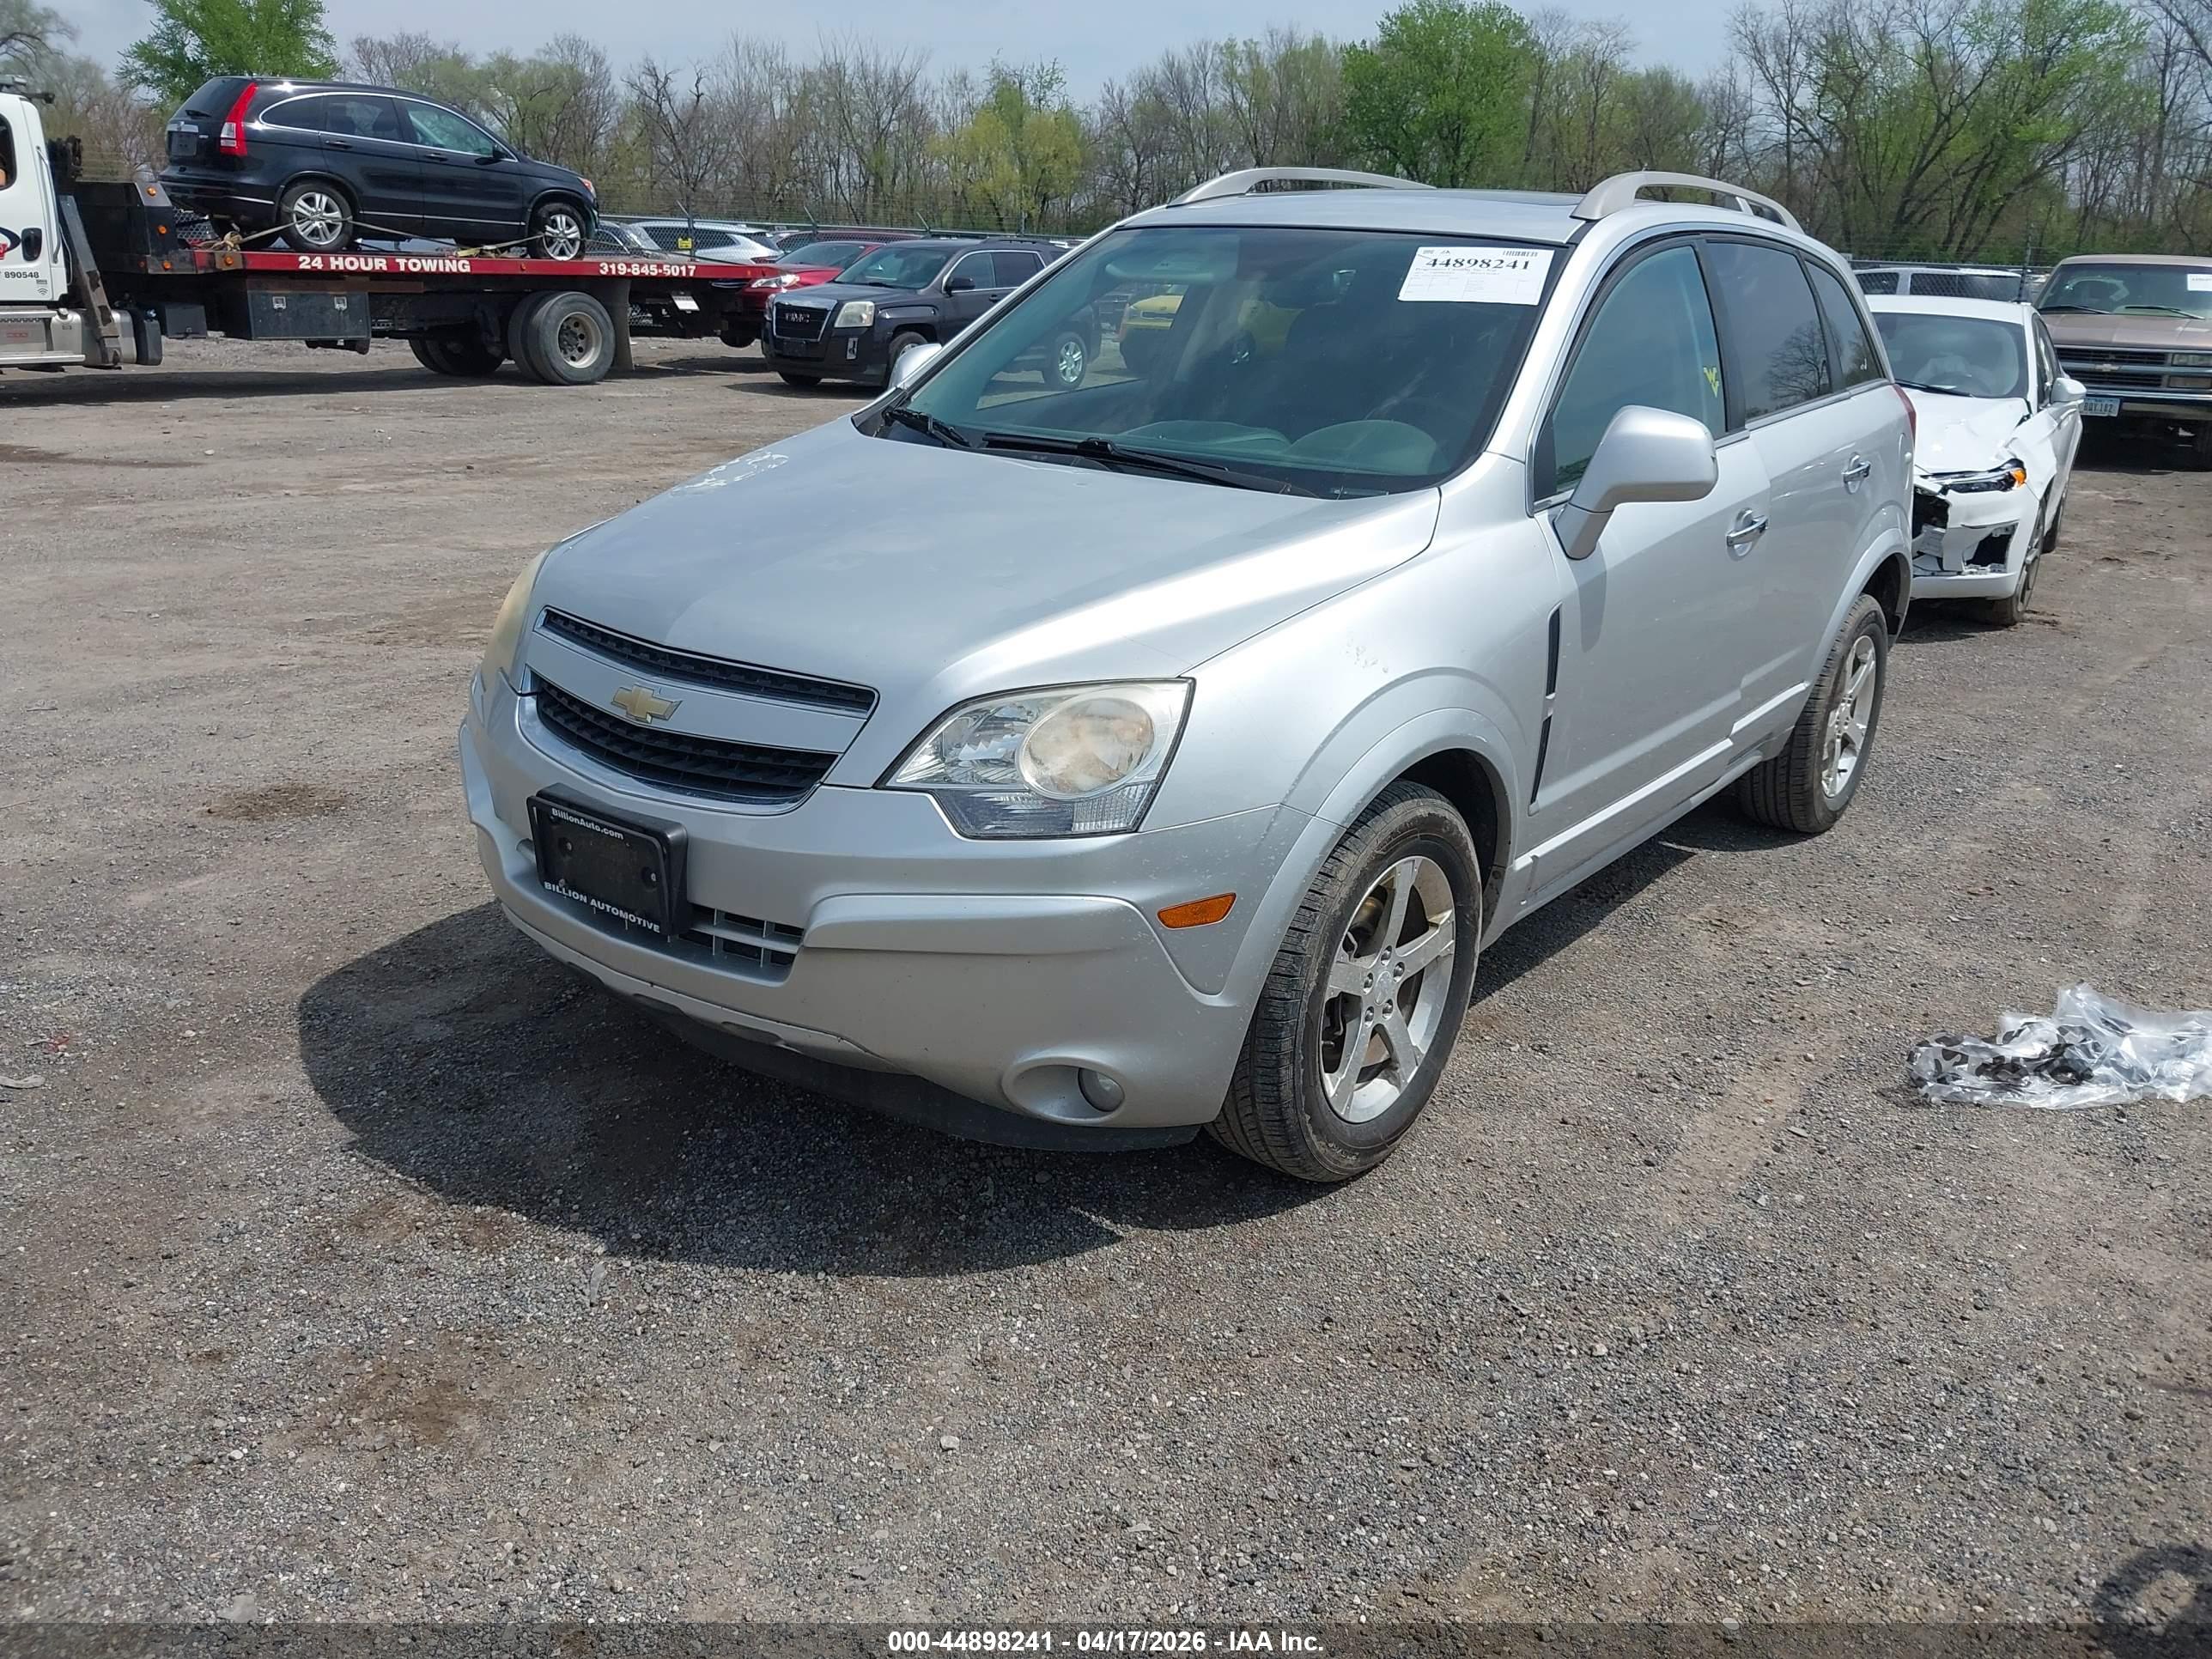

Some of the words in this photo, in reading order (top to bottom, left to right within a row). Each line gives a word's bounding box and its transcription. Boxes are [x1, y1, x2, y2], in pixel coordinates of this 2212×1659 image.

[298, 256, 324, 270] 24
[330, 257, 387, 271] HOUR
[395, 258, 471, 273] TOWING
[599, 262, 696, 276] 319-845-5017
[1425, 258, 1530, 270] 44898241
[551, 807, 624, 840] BillionAuto.com
[544, 881, 587, 903] BILLION
[590, 898, 660, 933] AUTOMOTIVE
